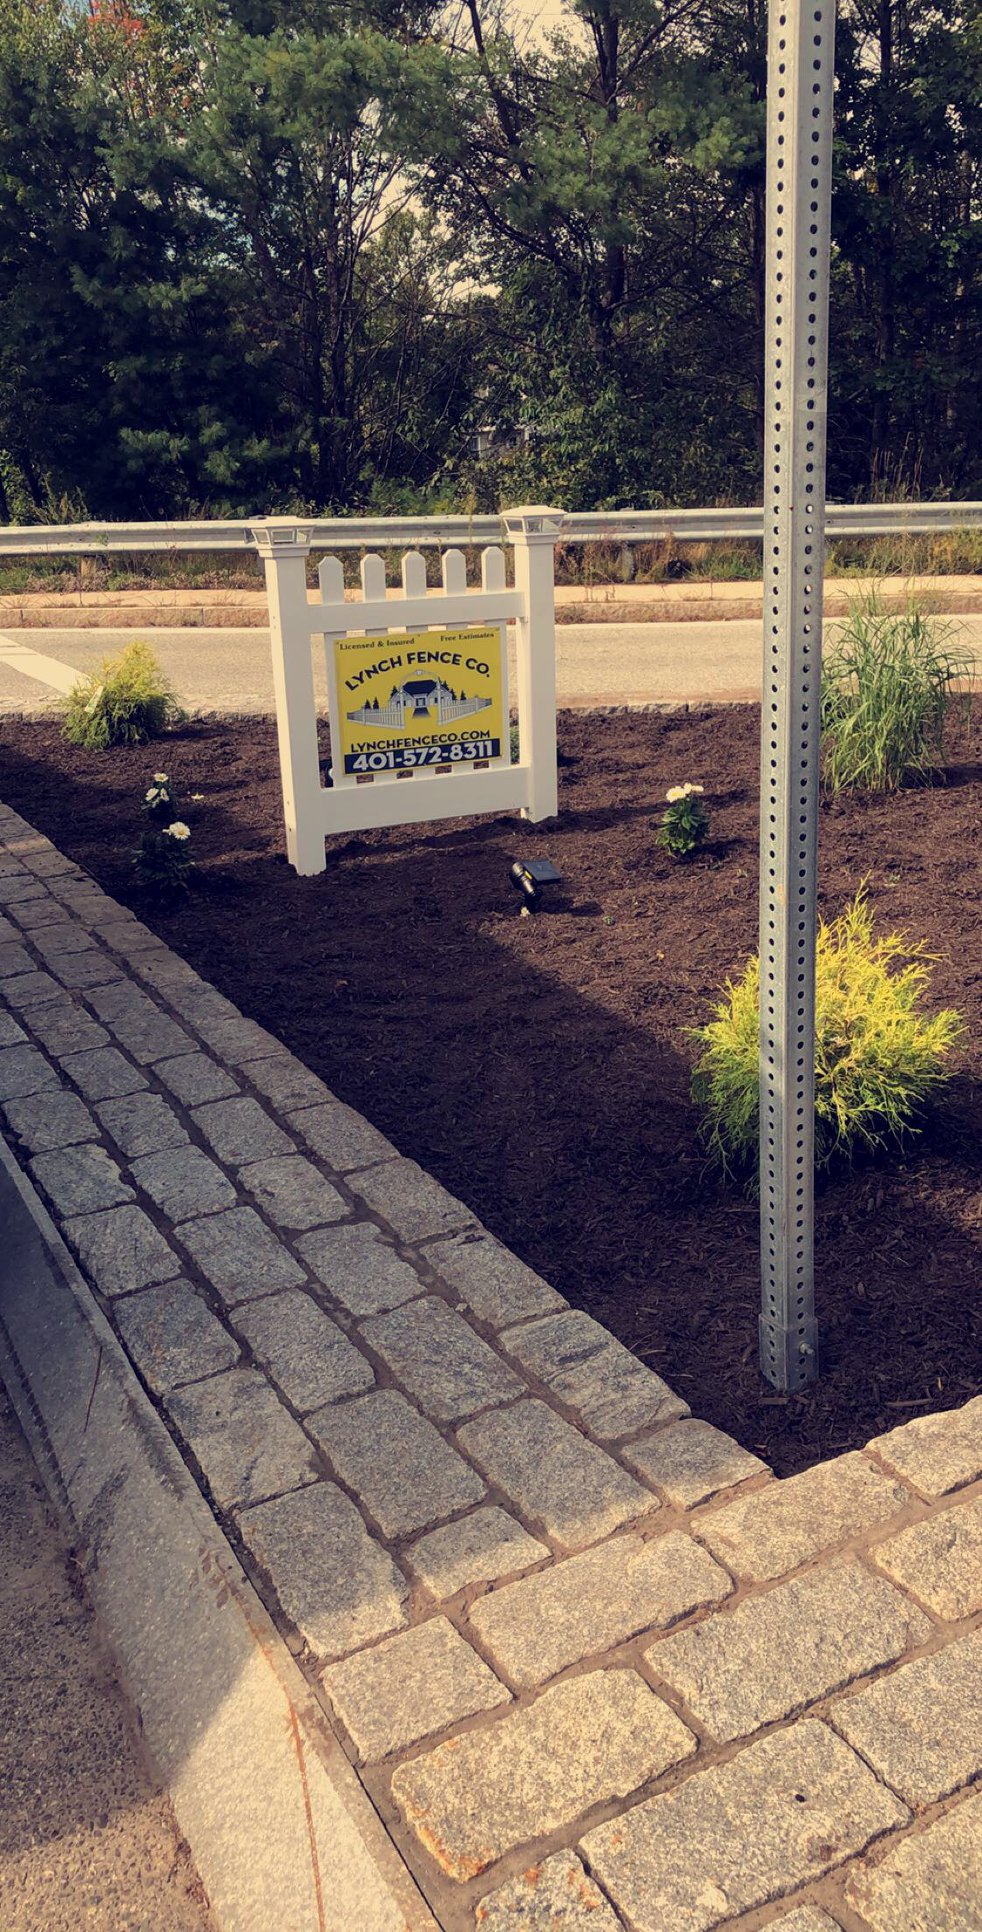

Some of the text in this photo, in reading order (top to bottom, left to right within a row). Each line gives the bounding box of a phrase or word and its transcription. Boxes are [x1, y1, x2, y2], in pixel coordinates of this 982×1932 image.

[339, 641, 375, 650] Licensed
[386, 638, 415, 646] Insured
[440, 632, 494, 642] Free Estimates
[345, 651, 490, 691] LYNCH FENCE CO.
[351, 729, 490, 753] LYNCHFENCECO.COM
[352, 740, 493, 771] 401-572-8311
